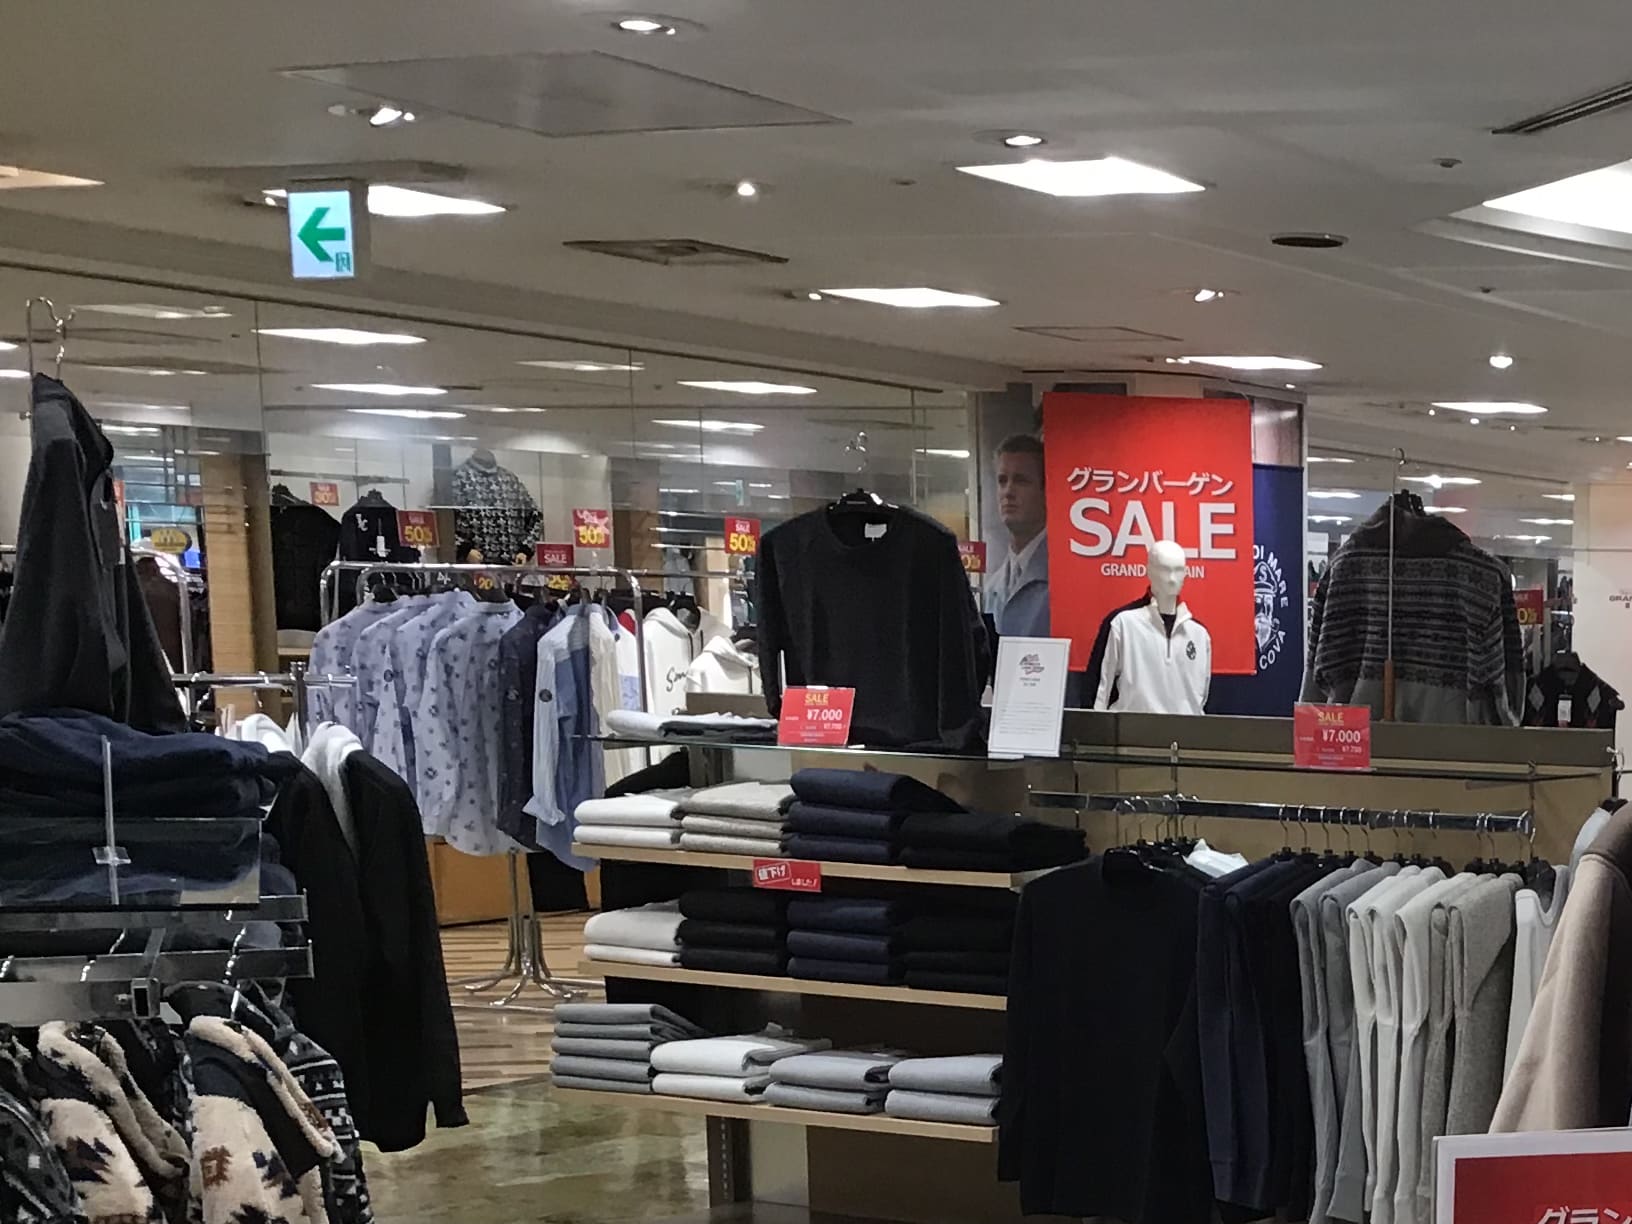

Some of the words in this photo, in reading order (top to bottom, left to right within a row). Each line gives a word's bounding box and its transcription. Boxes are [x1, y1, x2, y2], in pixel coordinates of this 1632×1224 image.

[1067, 467, 1234, 496] グランバーゲン
[1069, 497, 1236, 560] SALE
[544, 553, 567, 564] SALE
[1101, 562, 1147, 577] GRAND
[1318, 711, 1345, 720] SALE
